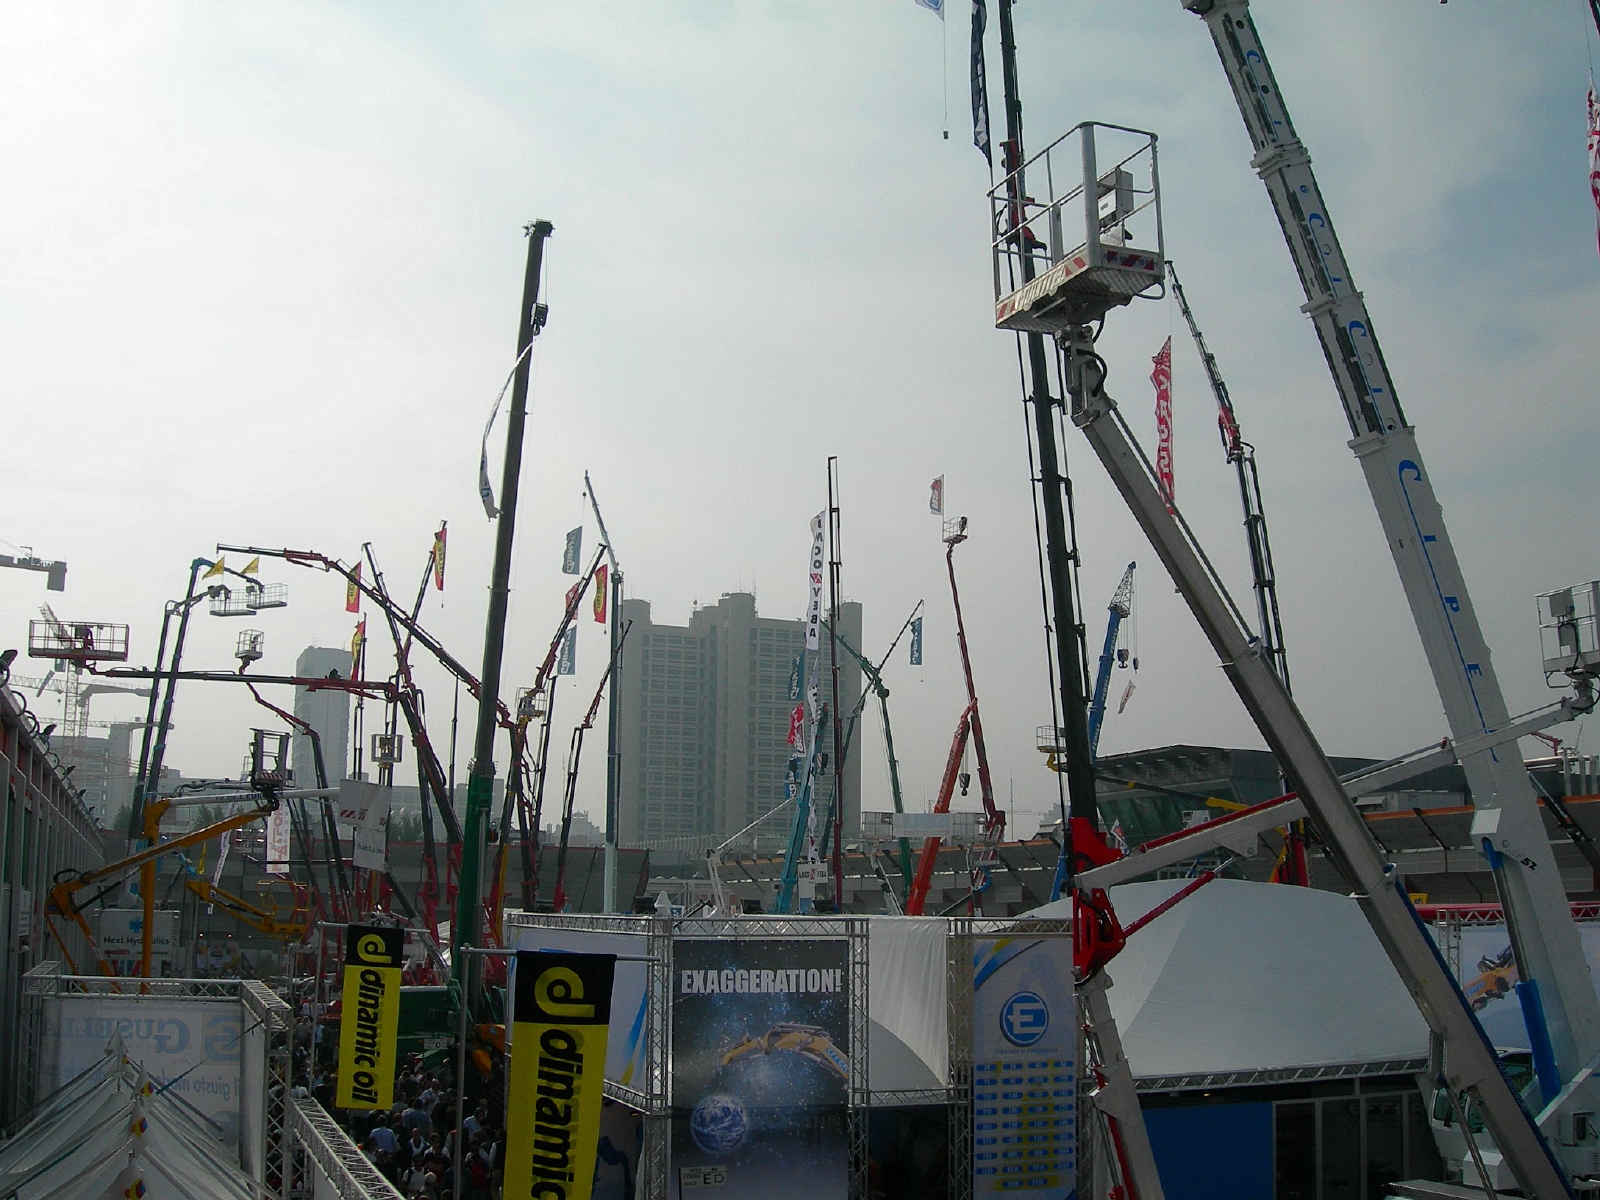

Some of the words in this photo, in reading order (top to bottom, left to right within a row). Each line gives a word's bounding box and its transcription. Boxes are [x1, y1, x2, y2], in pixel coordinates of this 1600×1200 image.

[103, 936, 124, 944] Next
[680, 967, 843, 995] EXAGGERATION!
[354, 969, 386, 1069] dinamic
[352, 1070, 378, 1104] oil
[530, 1028, 584, 1200] dinamic
[703, 1173, 712, 1185] E
